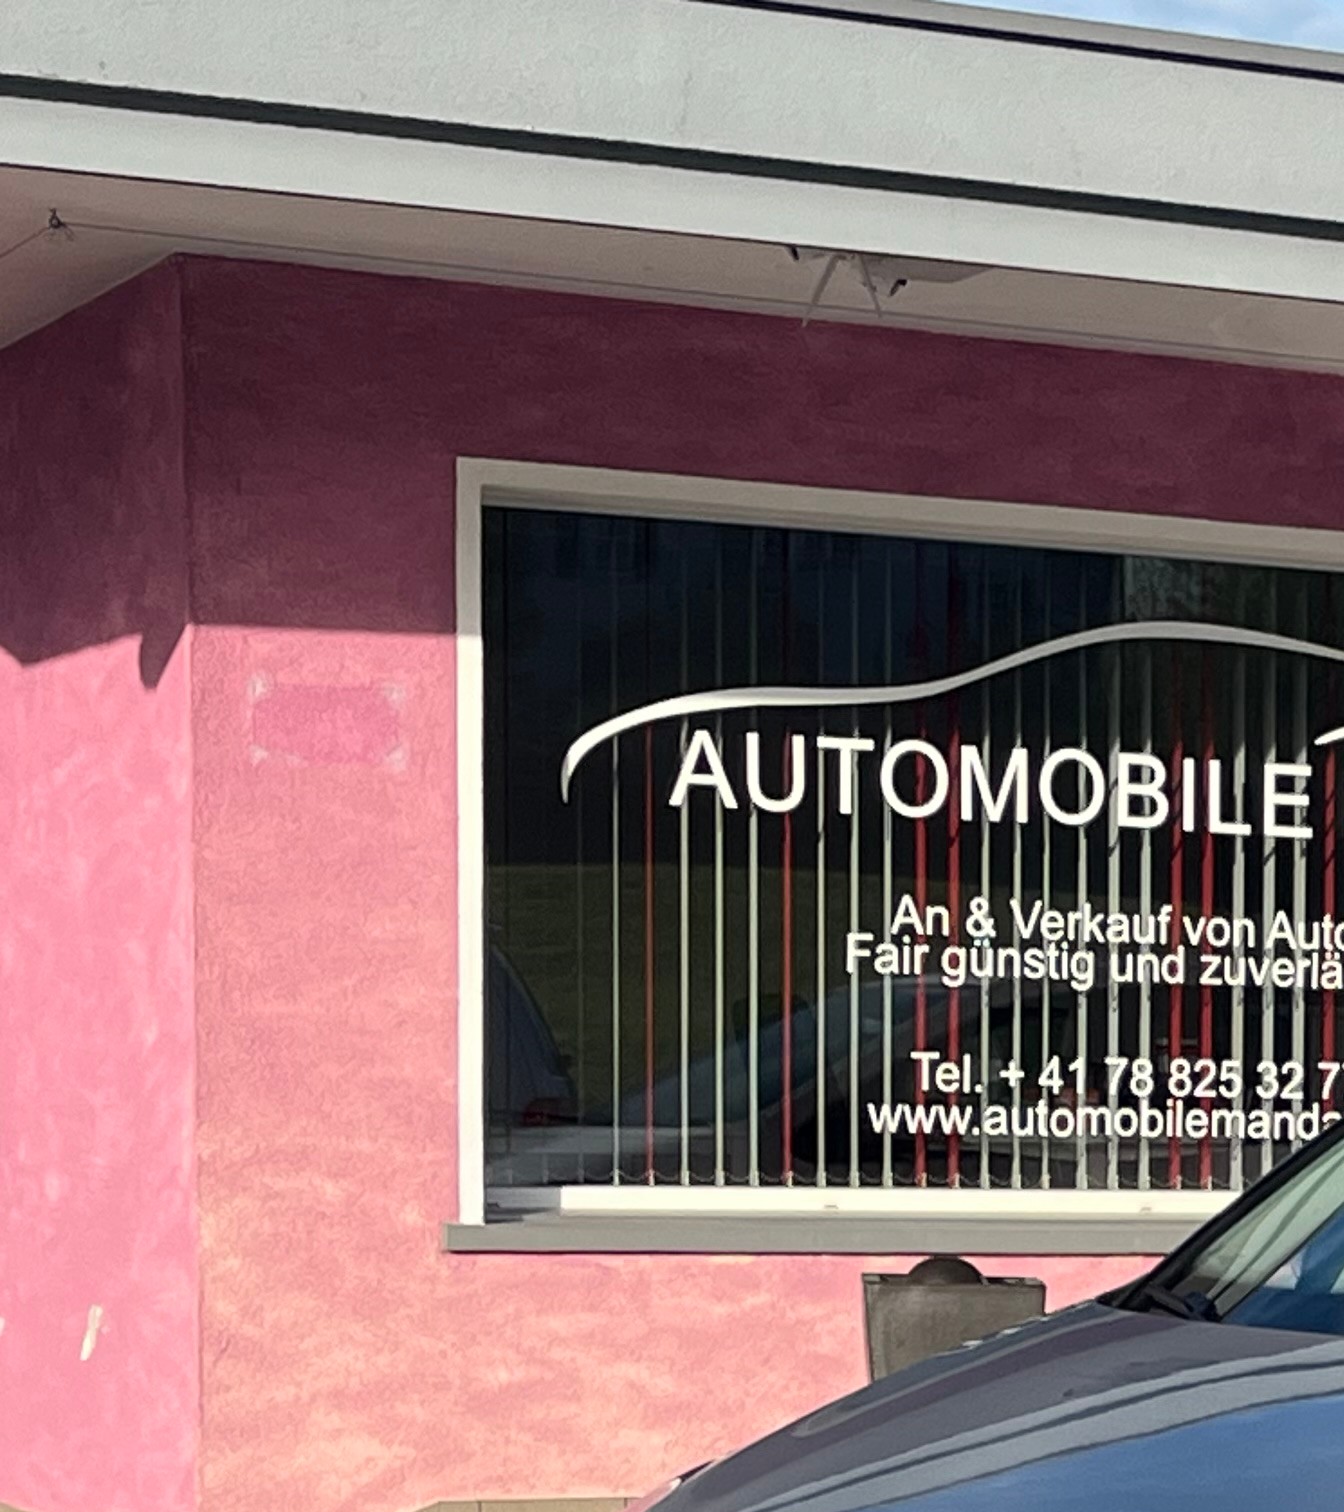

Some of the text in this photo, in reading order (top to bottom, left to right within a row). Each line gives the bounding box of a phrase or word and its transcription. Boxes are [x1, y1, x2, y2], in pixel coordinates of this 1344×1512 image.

[668, 729, 1313, 839] AUTOMOBILE
[891, 895, 949, 936] An
[965, 898, 995, 938] &
[1010, 899, 1171, 946] Verkauf
[1183, 915, 1254, 948] von
[846, 933, 929, 976] Fair
[941, 938, 1095, 992] günstig
[1110, 947, 1184, 984] und
[911, 1051, 983, 1093] Tel.
[1000, 1062, 1024, 1088] +
[1038, 1056, 1087, 1095] 41
[1103, 1058, 1154, 1097] 78
[1168, 1060, 1244, 1098] 825
[1255, 1061, 1303, 1100] 32
